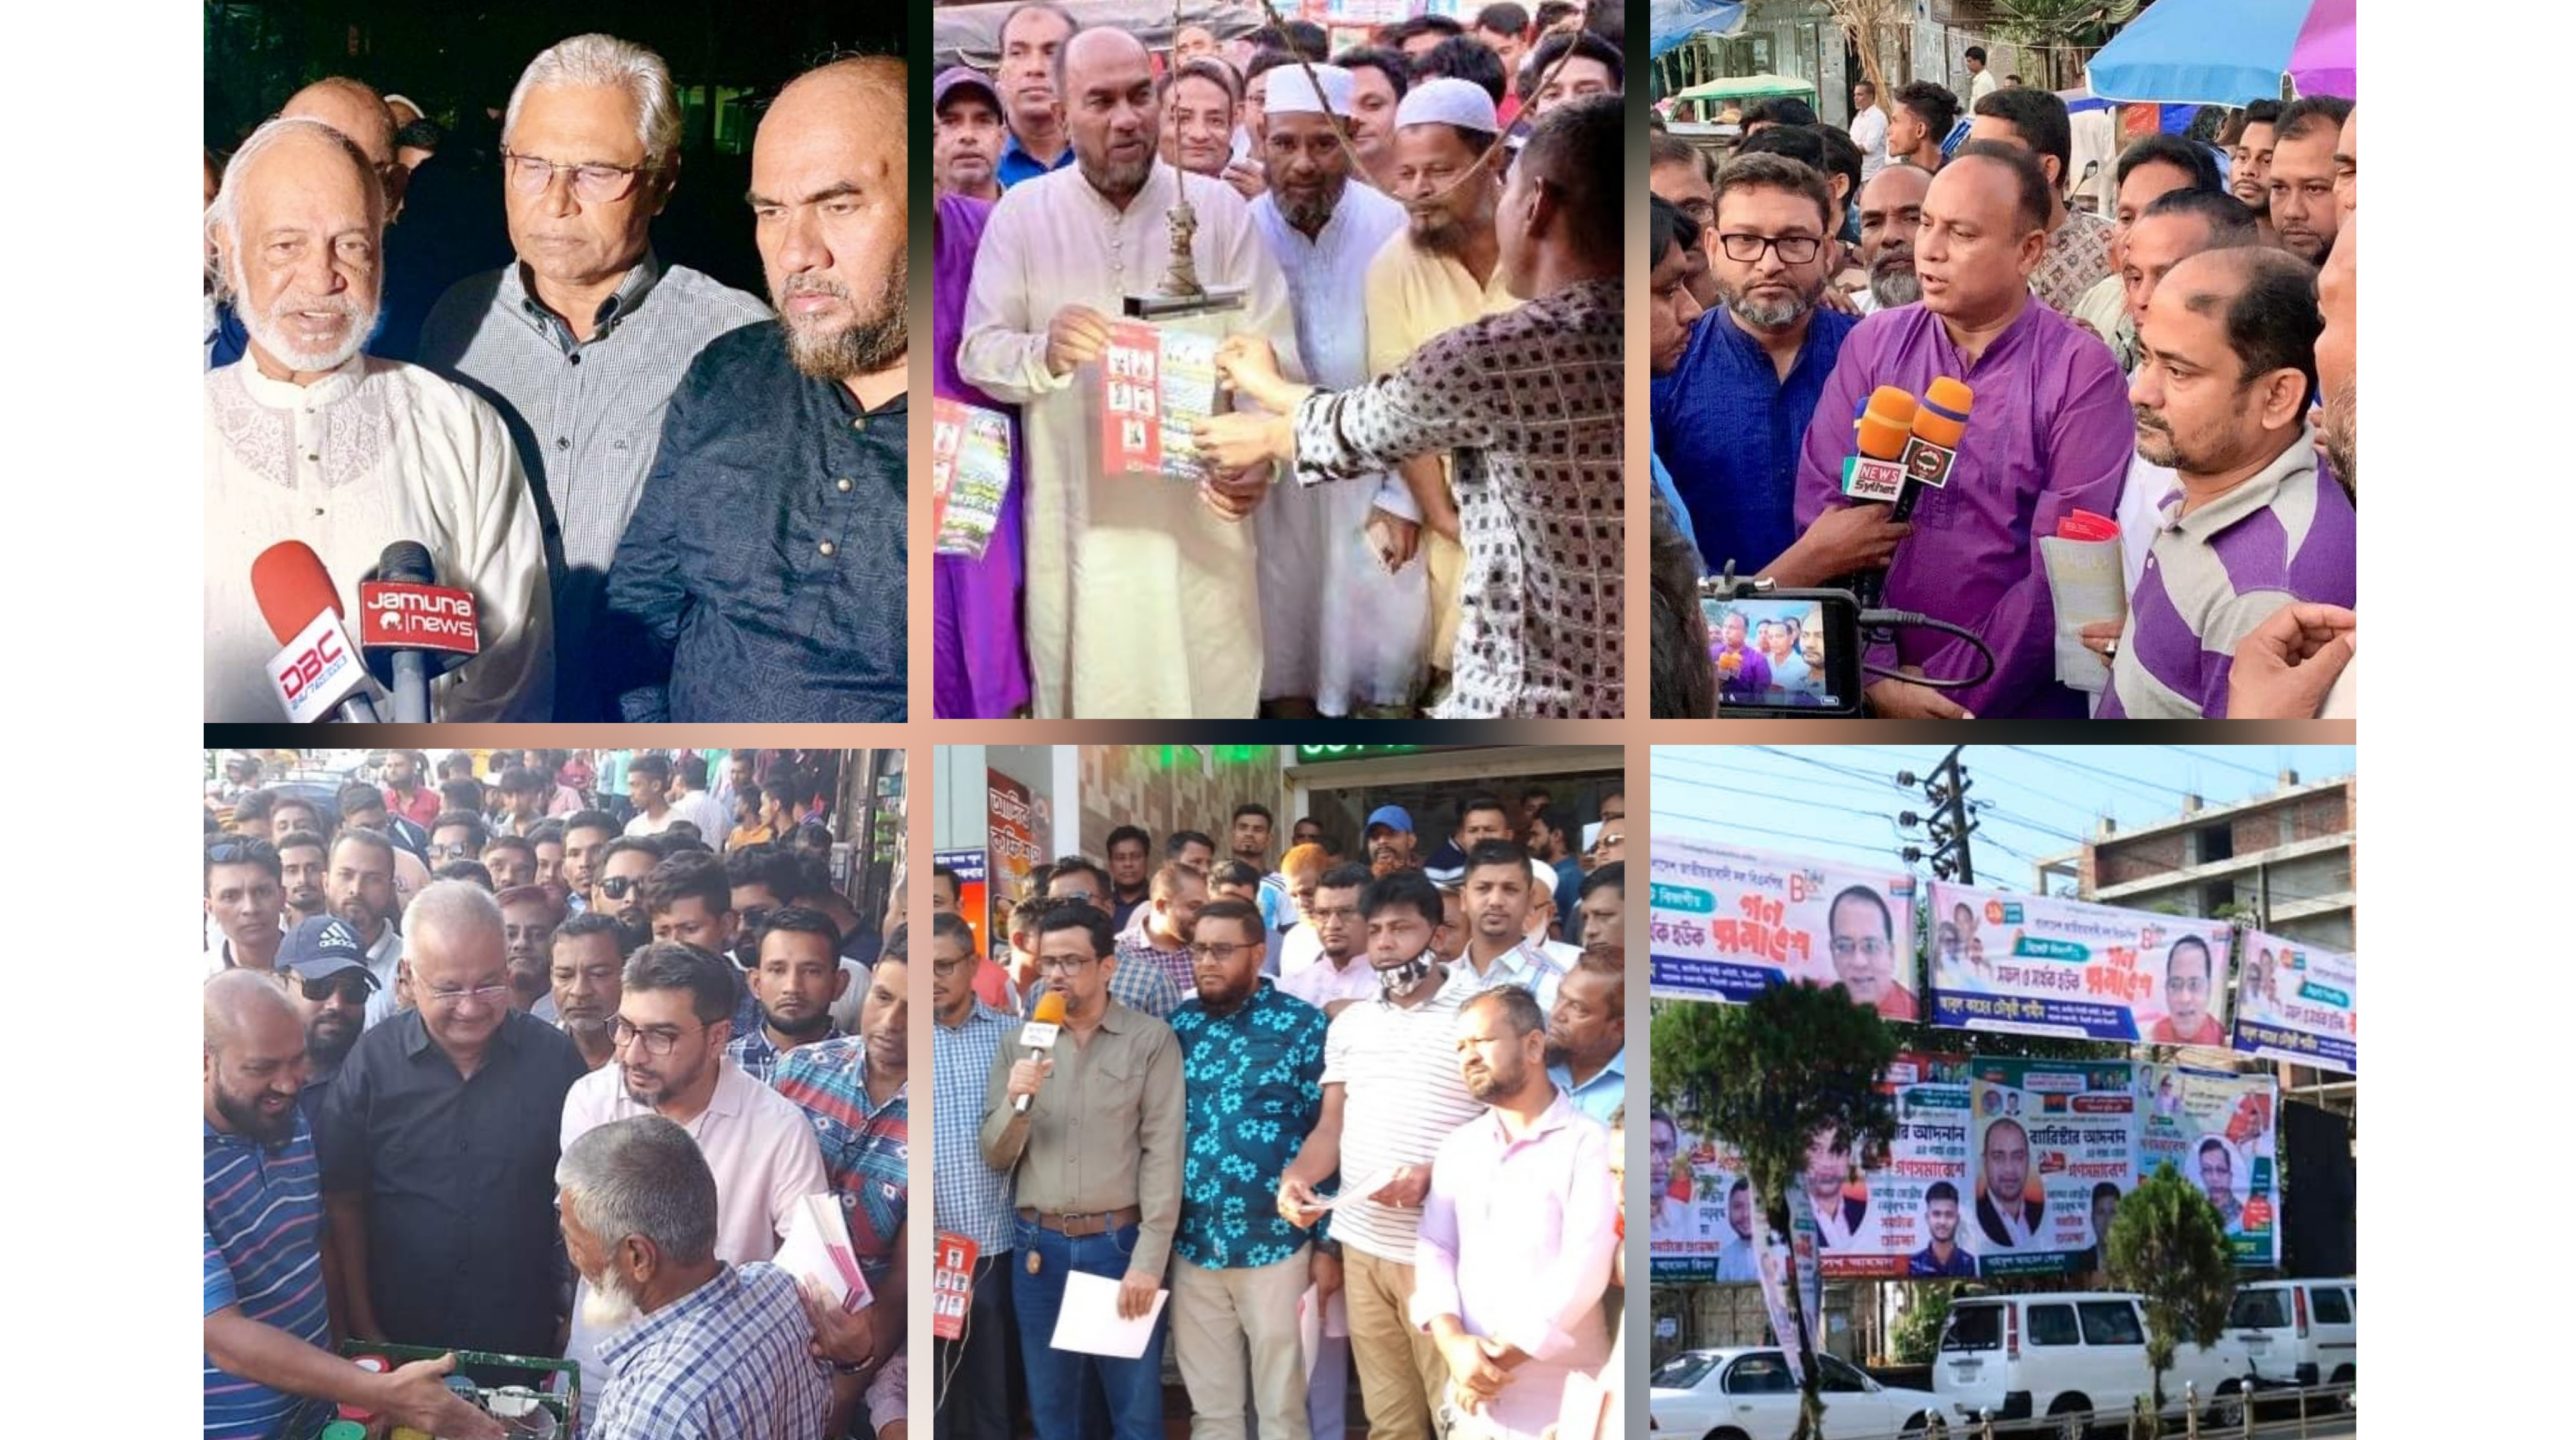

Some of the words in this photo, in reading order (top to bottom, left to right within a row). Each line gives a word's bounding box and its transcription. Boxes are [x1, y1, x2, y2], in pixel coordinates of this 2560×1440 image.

[1861, 464, 1899, 483] NEWS
[1854, 480, 1897, 495] Sylhet
[367, 592, 472, 617] Jamuna
[411, 614, 473, 637] news
[280, 629, 343, 699] DBC
[319, 938, 358, 951] adidas
